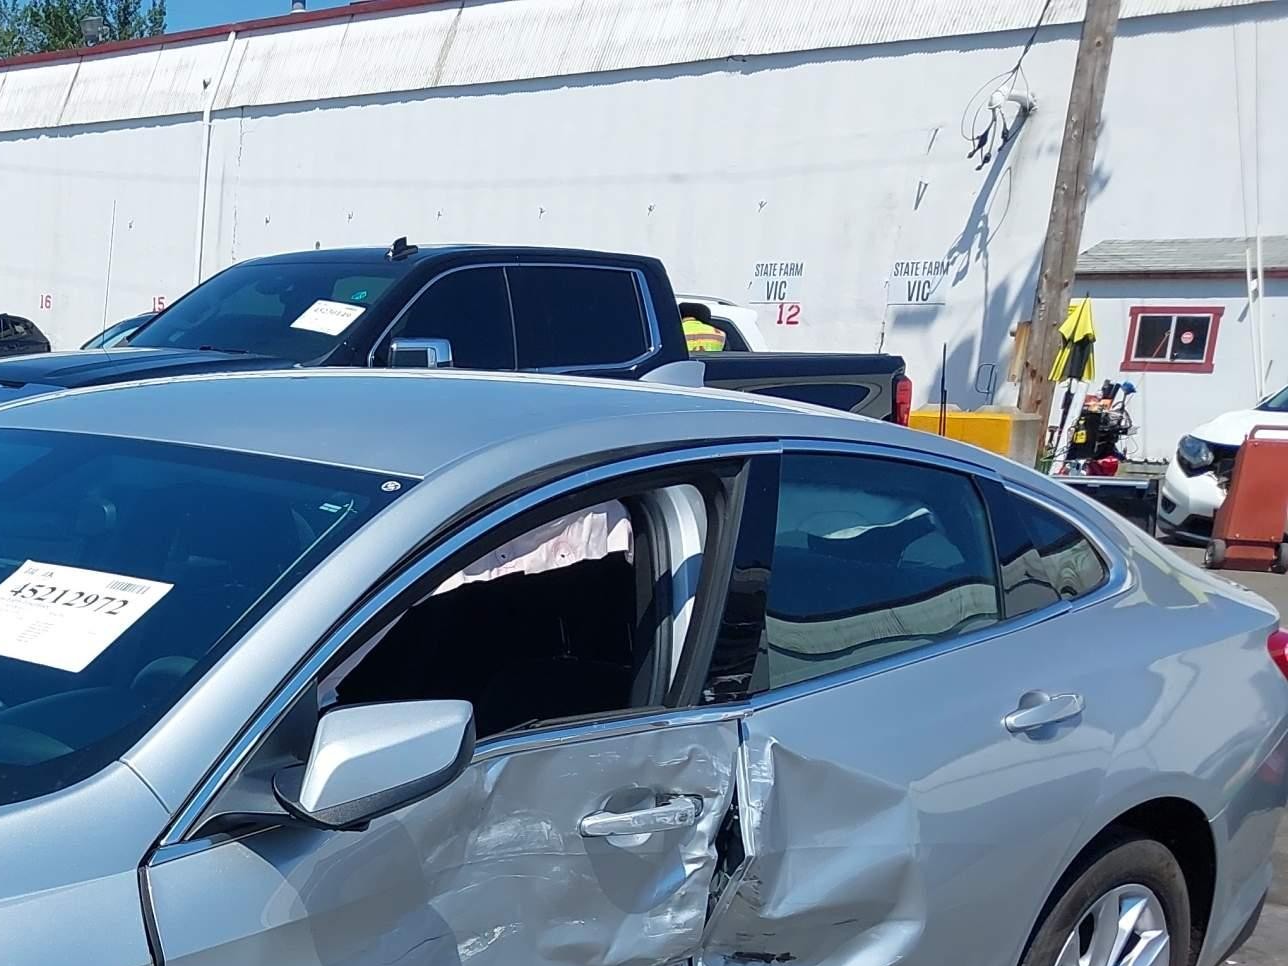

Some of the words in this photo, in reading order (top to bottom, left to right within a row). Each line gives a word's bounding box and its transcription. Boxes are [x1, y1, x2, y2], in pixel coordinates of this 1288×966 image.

[754, 263, 778, 277] STATE
[778, 262, 804, 277] FARM
[893, 262, 919, 276] STATE
[922, 261, 950, 276] FARM
[765, 280, 787, 301] VIC
[907, 280, 930, 302] VIC
[40, 294, 52, 309] 16
[153, 296, 165, 313] 15
[776, 303, 800, 325] 12
[10, 582, 129, 615] 45212972
